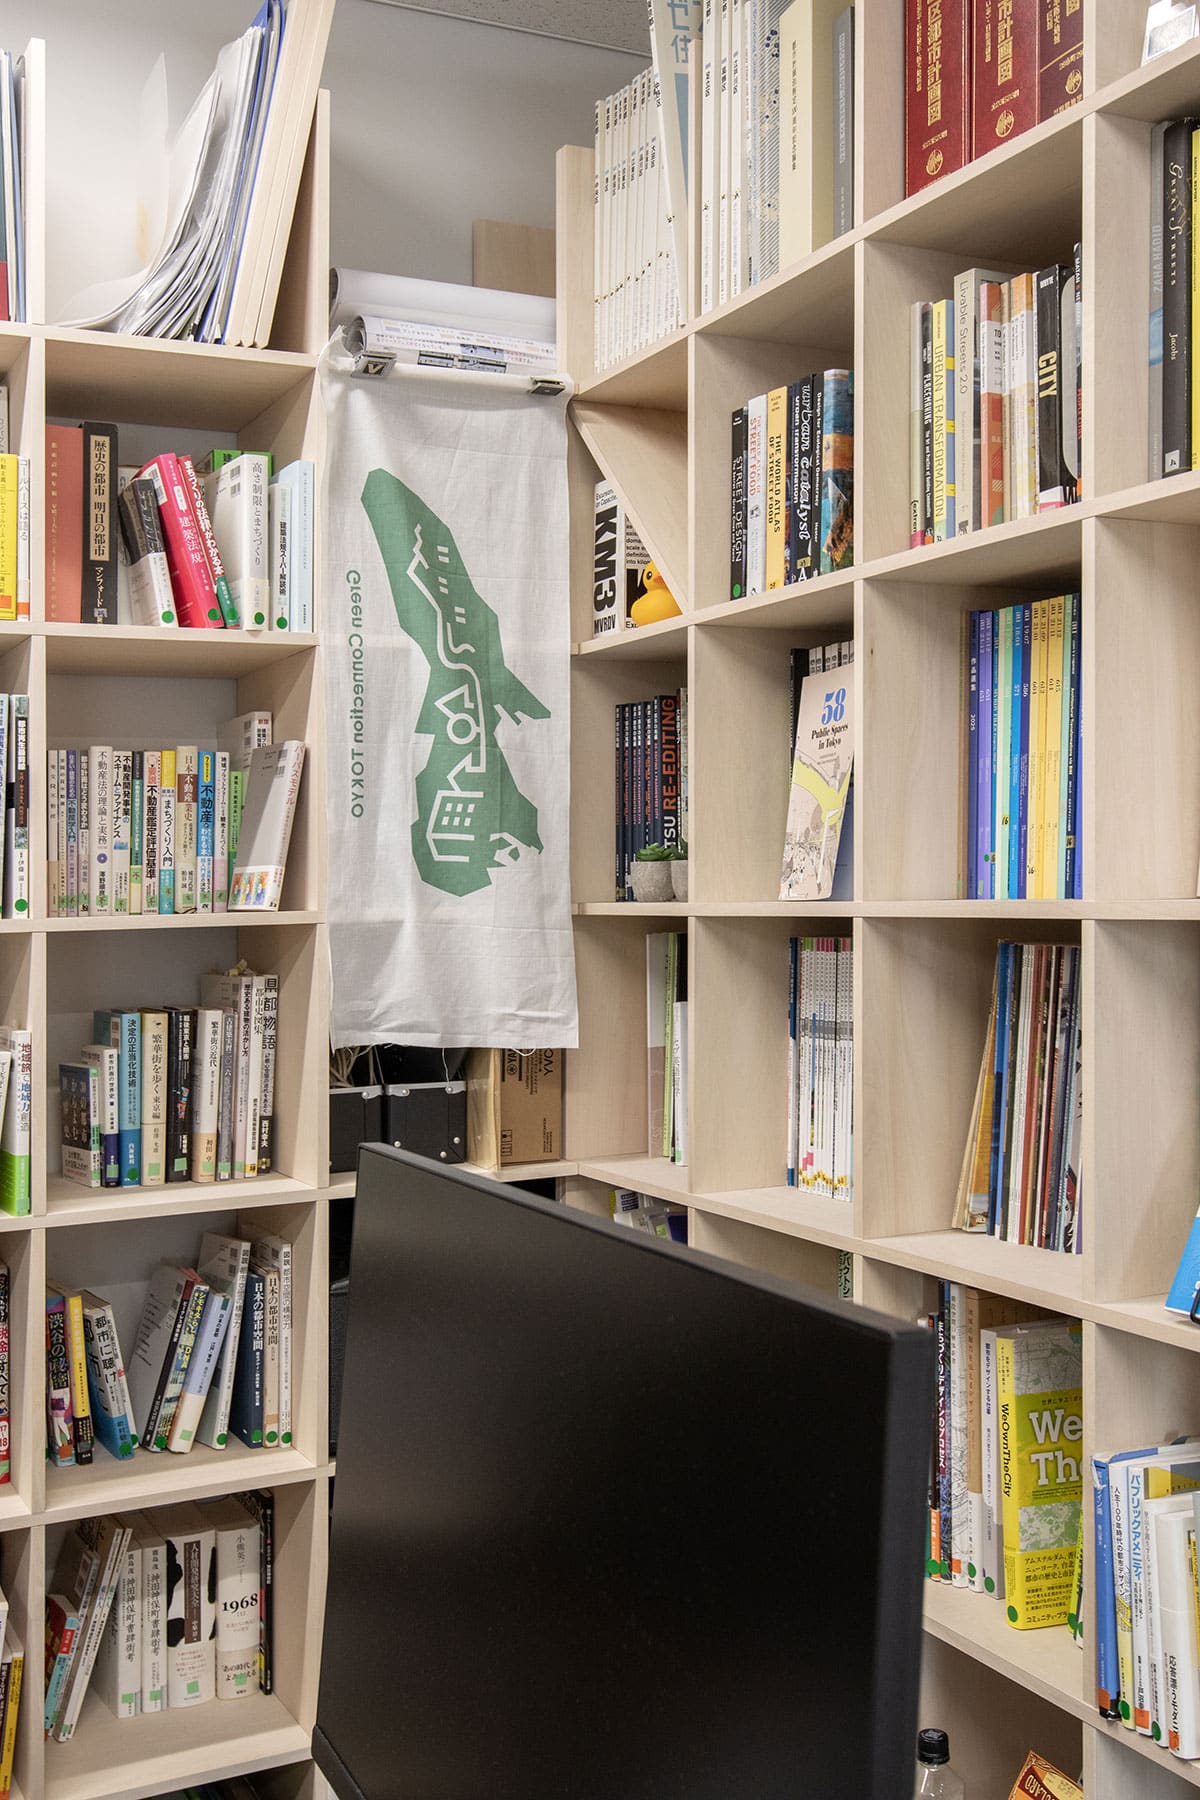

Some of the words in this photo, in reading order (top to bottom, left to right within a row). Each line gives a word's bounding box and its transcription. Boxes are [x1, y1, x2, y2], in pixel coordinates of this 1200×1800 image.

[959, 280, 970, 326] Livable
[934, 344, 946, 392] URBAN
[959, 327, 970, 372] Streets
[1168, 332, 1180, 361] Jacobs
[923, 373, 932, 425] PLACEMAKING
[959, 373, 969, 395] 2.0
[1038, 351, 1057, 398] CITY
[813, 392, 821, 417] Design
[749, 417, 757, 461] STREET
[768, 436, 774, 448] OF
[774, 434, 782, 456] THE
[934, 396, 947, 519] TRANSFORMATION
[93, 439, 106, 497] 歴史の都市
[735, 455, 743, 505] STREET
[749, 463, 757, 496] FOOD
[774, 458, 782, 496] WORLD
[813, 467, 821, 506] Democracy
[93, 501, 106, 557] 明日の都市
[251, 461, 263, 566] 高さ制限とまちづくり
[735, 511, 743, 563] DESIGN
[594, 505, 618, 612] KM3
[95, 567, 104, 608] マンフォード
[593, 613, 617, 635] MVRDV
[811, 726, 831, 741] Public
[830, 722, 849, 736] Spaces
[821, 687, 847, 726] 58
[661, 699, 676, 811] RE-EDITING
[818, 741, 825, 750] in
[825, 736, 842, 749] Tokyo
[97, 751, 107, 847] 不動産法の理論と実務
[113, 755, 122, 839] スキームとファイナンス
[122, 755, 131, 823] 不動産開発事業の
[184, 754, 194, 822] 日本不動産業史
[286, 743, 306, 806] パーパスモデル
[200, 784, 213, 823] 不動産
[146, 784, 158, 879] 不動産鑑定評価基準
[162, 801, 173, 867] まちづくり入門
[254, 987, 263, 1036] 都市史図集
[262, 978, 278, 1050] 県都物語
[127, 1018, 137, 1089] 決定の正当化技術
[151, 1033, 163, 1095] 繁華街を歩く
[209, 1020, 218, 1068] 繁華街の近代
[152, 1096, 161, 1119] 東京編
[253, 1282, 265, 1351] 日本の都市空間
[267, 1278, 278, 1346] 日本の都市空間
[50, 1311, 69, 1390] 渋谷の秘密
[95, 1315, 117, 1386] 都市に聴け
[938, 1320, 946, 1469] まちづくりデザインのプロセス
[1000, 1403, 1011, 1498] WeOwnTheCity
[1029, 1408, 1083, 1445] We
[1030, 1451, 1083, 1486] Th
[1130, 1474, 1143, 1581] パブリックアメニティ
[222, 1593, 259, 1615] 1968
